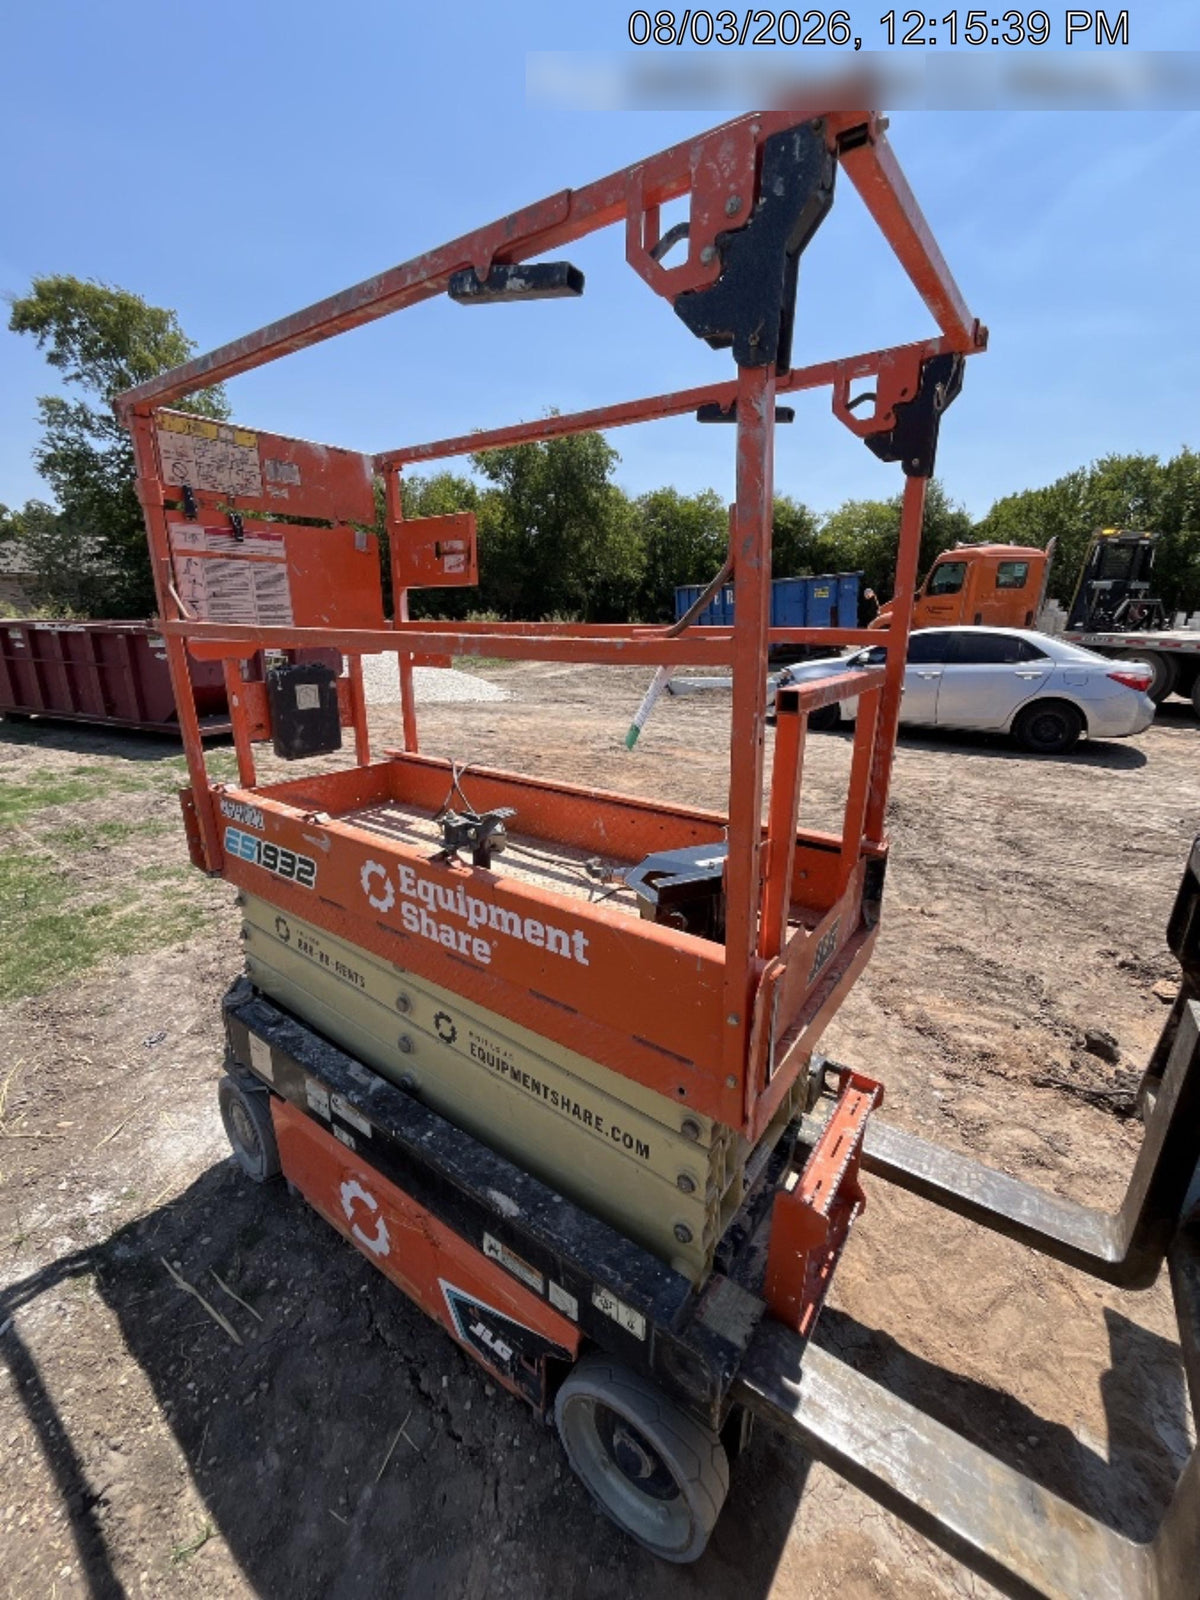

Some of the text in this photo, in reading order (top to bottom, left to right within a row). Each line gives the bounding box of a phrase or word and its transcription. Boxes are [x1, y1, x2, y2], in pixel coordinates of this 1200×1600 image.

[224, 826, 316, 889] ES1932
[398, 864, 590, 966] Equipment
[401, 900, 491, 964] Share
[470, 1042, 650, 1160] EQUIPMENTSHARE.COM
